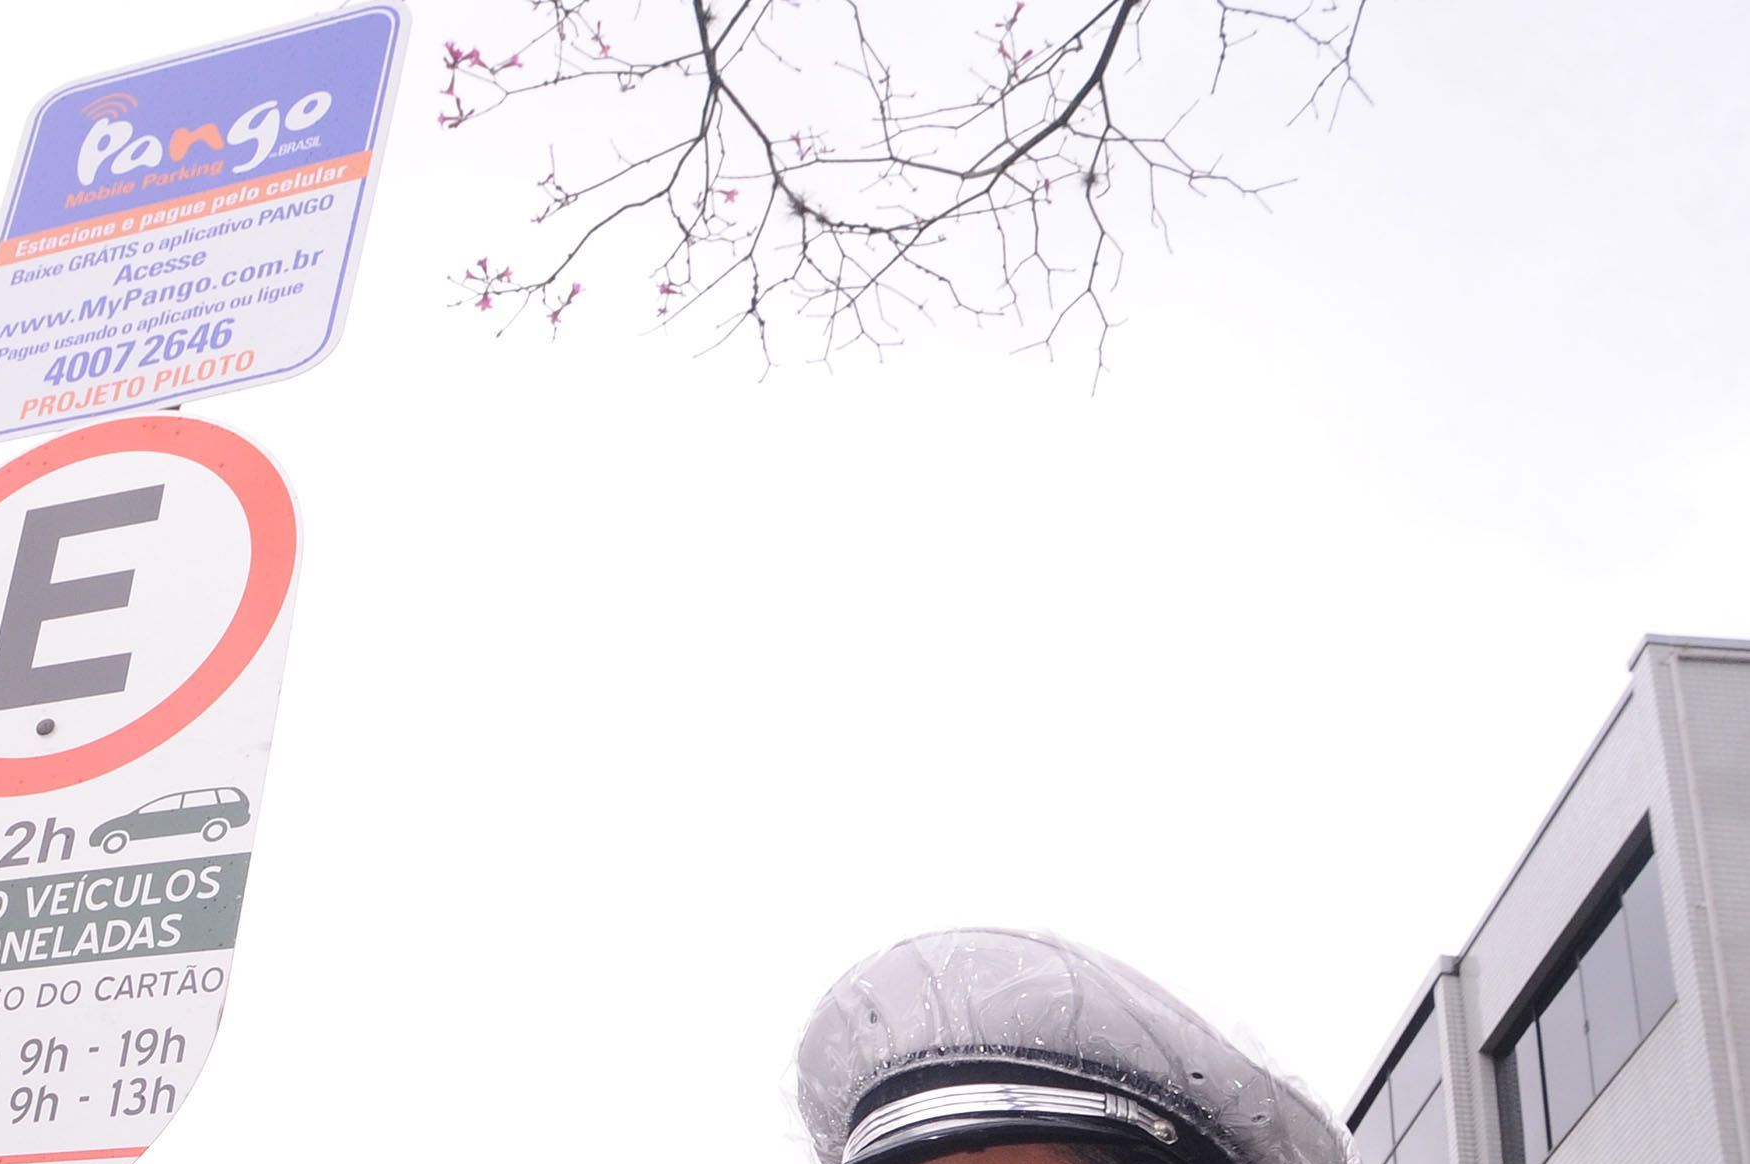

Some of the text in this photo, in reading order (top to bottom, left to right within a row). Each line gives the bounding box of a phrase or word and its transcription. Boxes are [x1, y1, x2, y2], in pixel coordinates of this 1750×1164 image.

[77, 91, 332, 185] Pango
[278, 136, 322, 156] BRASIL
[15, 165, 347, 257] Estacione e pague pelo celular
[64, 160, 224, 208] Mobile Parking
[10, 194, 335, 286] Baixe GRÁTIS o aplicativo PANGO
[113, 250, 207, 286] Acesse
[54, 325, 117, 350] usando
[121, 323, 133, 335] o
[137, 302, 225, 333] aplicativo
[230, 295, 253, 310] ou
[257, 282, 304, 304] ligue
[43, 317, 235, 387] 4007 2646
[19, 349, 256, 420] PROJETO PILOTO
[26, 865, 222, 919] VEÍCULOS
[36, 980, 85, 1009] DO
[94, 964, 224, 1002] CARTÃO
[19, 1036, 68, 1076] 9h
[118, 1027, 185, 1067] 19h
[9, 1087, 58, 1125] 9h
[109, 1076, 175, 1118] 13h
